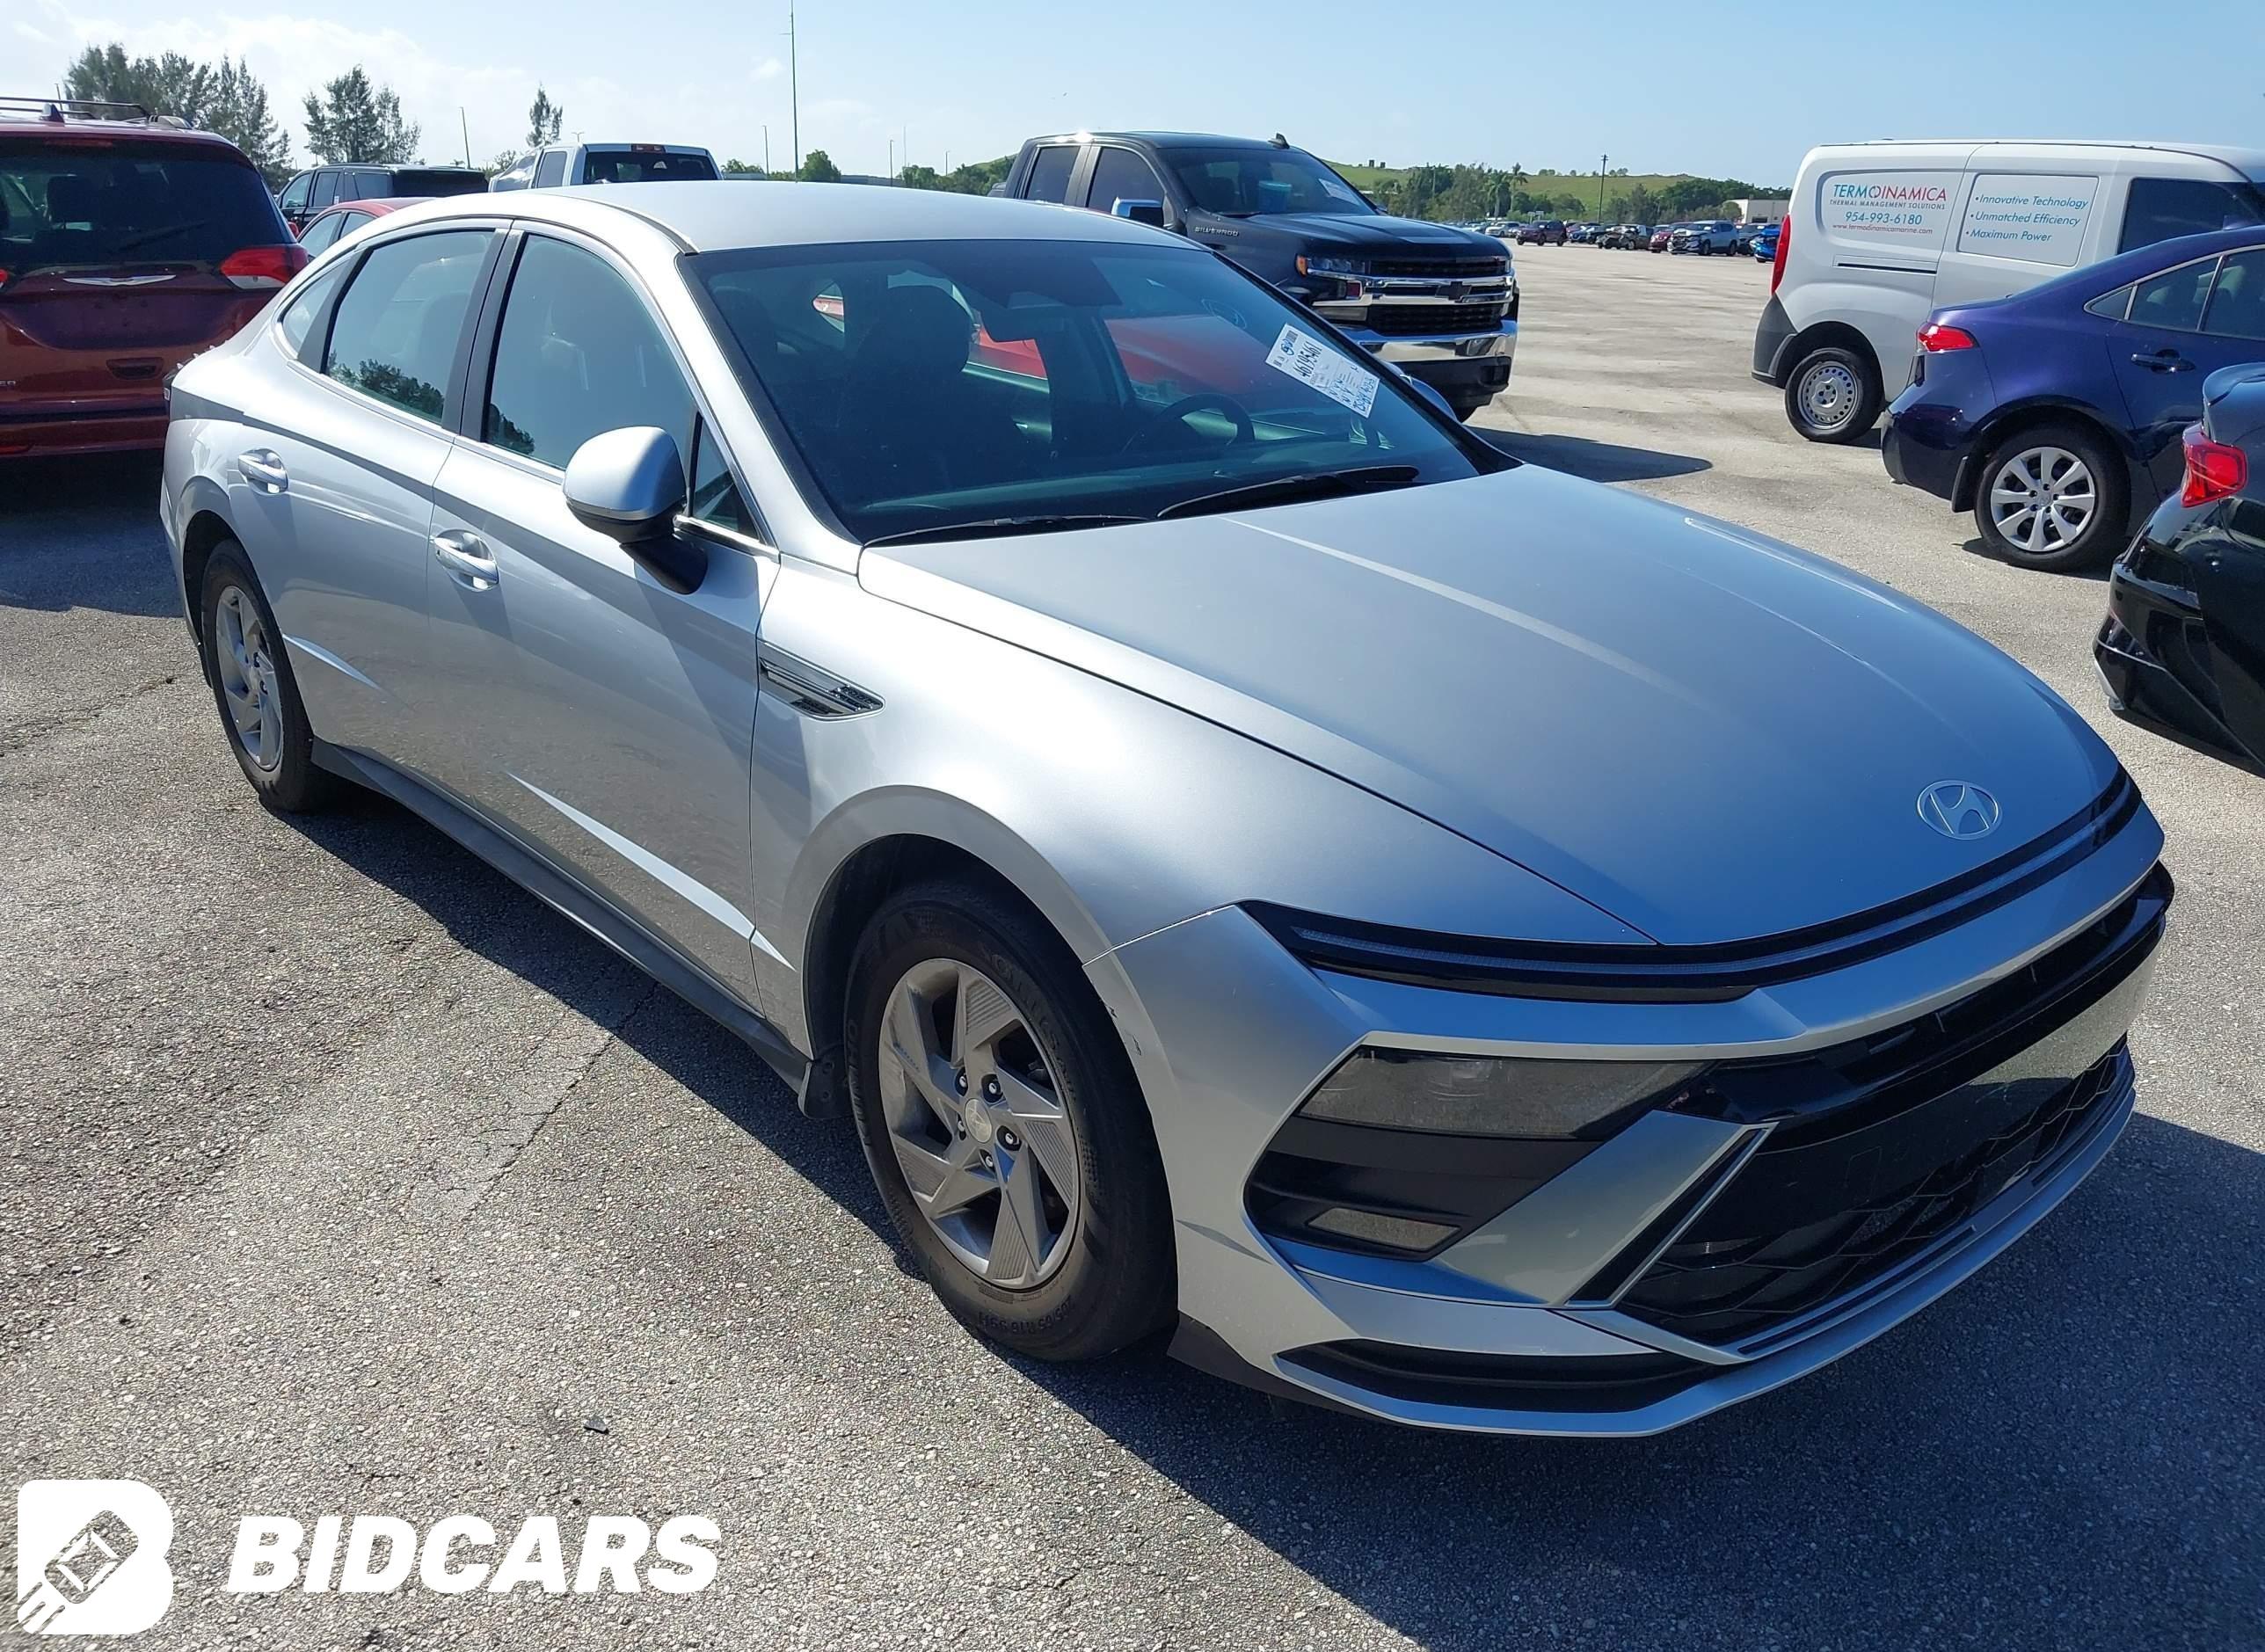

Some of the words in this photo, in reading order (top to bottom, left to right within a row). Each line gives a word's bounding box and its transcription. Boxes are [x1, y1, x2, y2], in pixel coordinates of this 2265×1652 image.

[1979, 194, 2029, 205] Innovative
[2032, 196, 2089, 210] Technology
[1846, 211, 1923, 224] 954-993-6180
[1975, 211, 2031, 222] Unmatched
[2033, 214, 2080, 227] Efficiency
[1970, 229, 2018, 240] Maximum
[2021, 231, 2052, 242] Power
